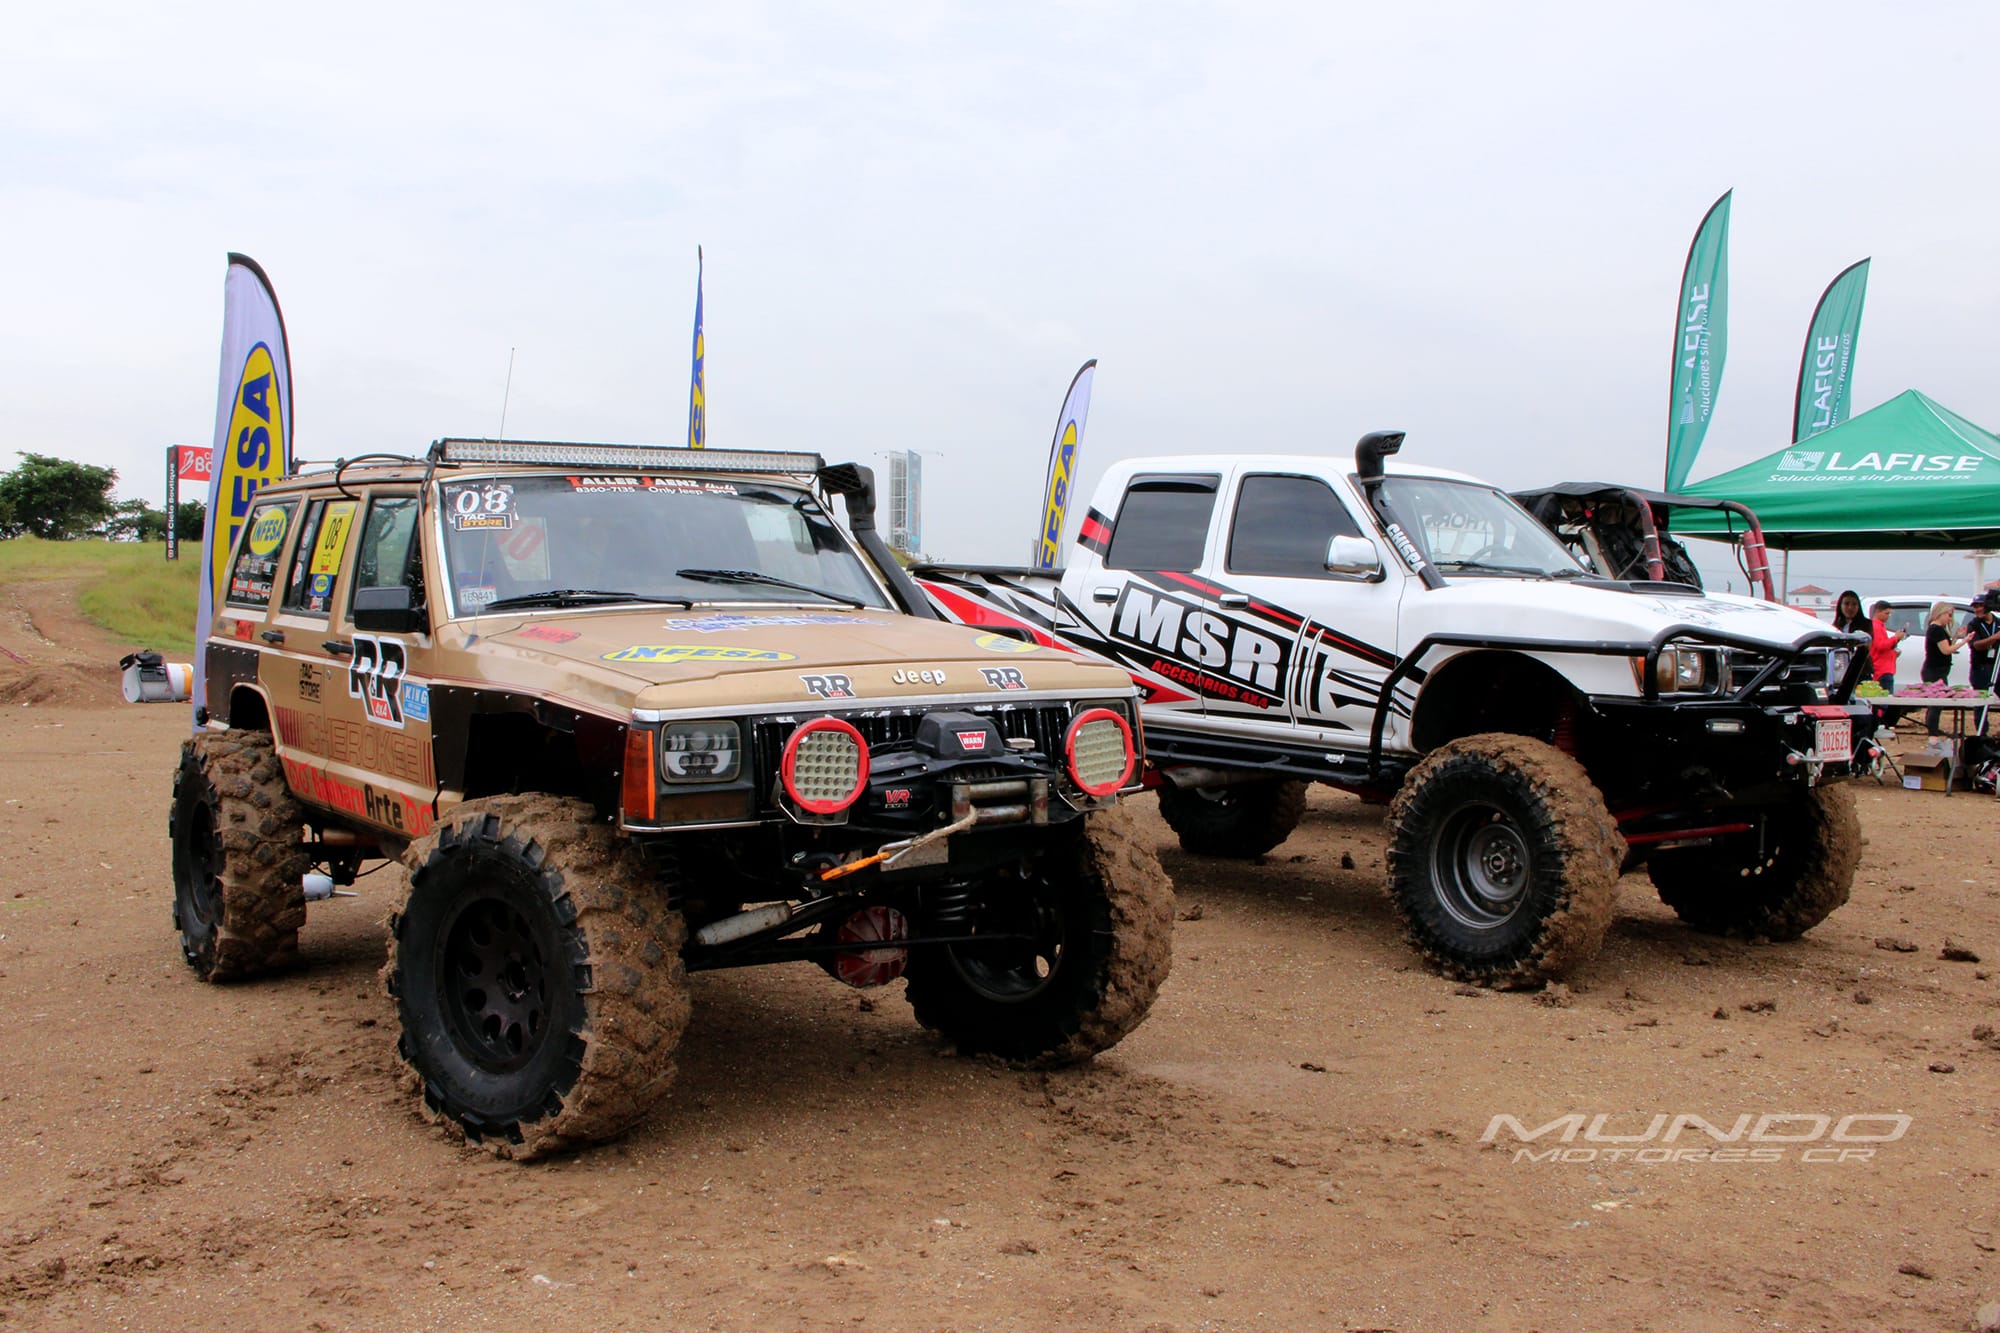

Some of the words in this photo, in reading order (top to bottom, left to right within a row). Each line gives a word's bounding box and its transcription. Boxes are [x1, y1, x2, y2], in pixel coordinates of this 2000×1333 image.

[1812, 335, 1839, 428] LAFISE
[1825, 452, 1984, 471] LAFISE
[566, 476, 639, 487] TALLER
[1767, 474, 1855, 482] Soluciones
[1885, 474, 1973, 482] fronteras
[648, 487, 677, 496] Only
[456, 491, 508, 514] 08
[252, 519, 285, 543] INFESA
[462, 519, 504, 527] STORE
[325, 518, 343, 550] 08
[1386, 523, 1427, 575] CHISPA
[1118, 587, 1283, 692] MSR
[613, 646, 781, 660] INFESA
[893, 668, 947, 685] Jeep
[1151, 660, 1239, 698] ACCESORIOS
[299, 680, 320, 699] STORE
[304, 713, 418, 784] CHEROKEE
[963, 736, 982, 745] WARN
[1822, 731, 1849, 752] 202623
[885, 789, 910, 803] VR
